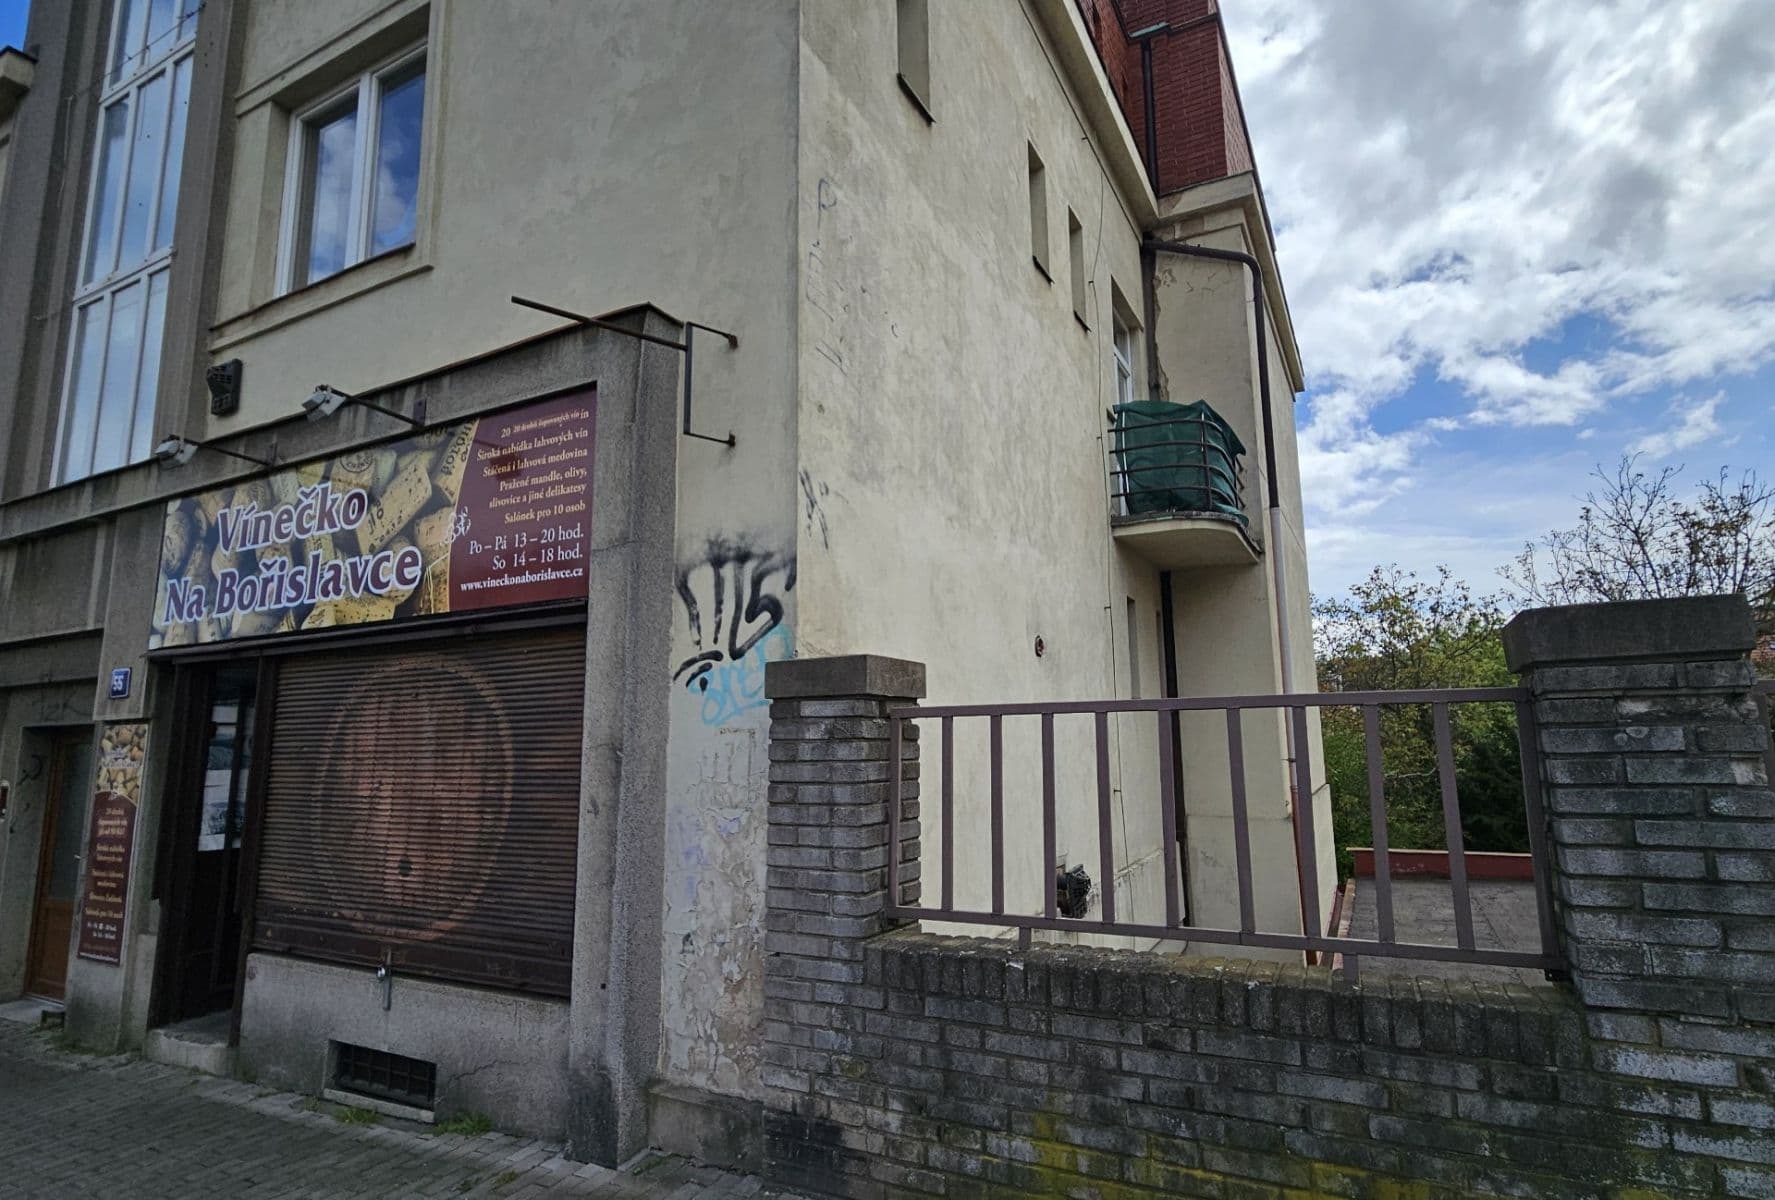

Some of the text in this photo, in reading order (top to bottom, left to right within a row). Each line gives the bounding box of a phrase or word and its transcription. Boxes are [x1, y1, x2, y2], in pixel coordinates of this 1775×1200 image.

[501, 427, 511, 438] 20
[502, 440, 533, 454] nabídka
[534, 430, 573, 448] lahvových
[575, 428, 588, 438] vín
[483, 462, 511, 477] Stáčená
[517, 454, 546, 469] lahvová
[547, 448, 588, 463] medovina
[489, 494, 521, 508] slivovice
[528, 490, 544, 503] jiné
[545, 482, 587, 498] delikatesy
[500, 477, 529, 491] Pražené
[218, 481, 368, 554] Vínečko
[505, 499, 586, 524] Salónek pro 10 osob
[469, 540, 482, 554] Po
[495, 535, 507, 551] Pá
[514, 532, 527, 548] 13
[540, 527, 555, 543] 20
[558, 522, 584, 541] hod.
[492, 555, 506, 570] So
[513, 550, 526, 567] 14
[541, 548, 554, 563] 18
[558, 543, 583, 561] hod.
[162, 546, 422, 625] Na Bořislavce
[460, 567, 583, 591] www.vineckonaborislavce.cz
